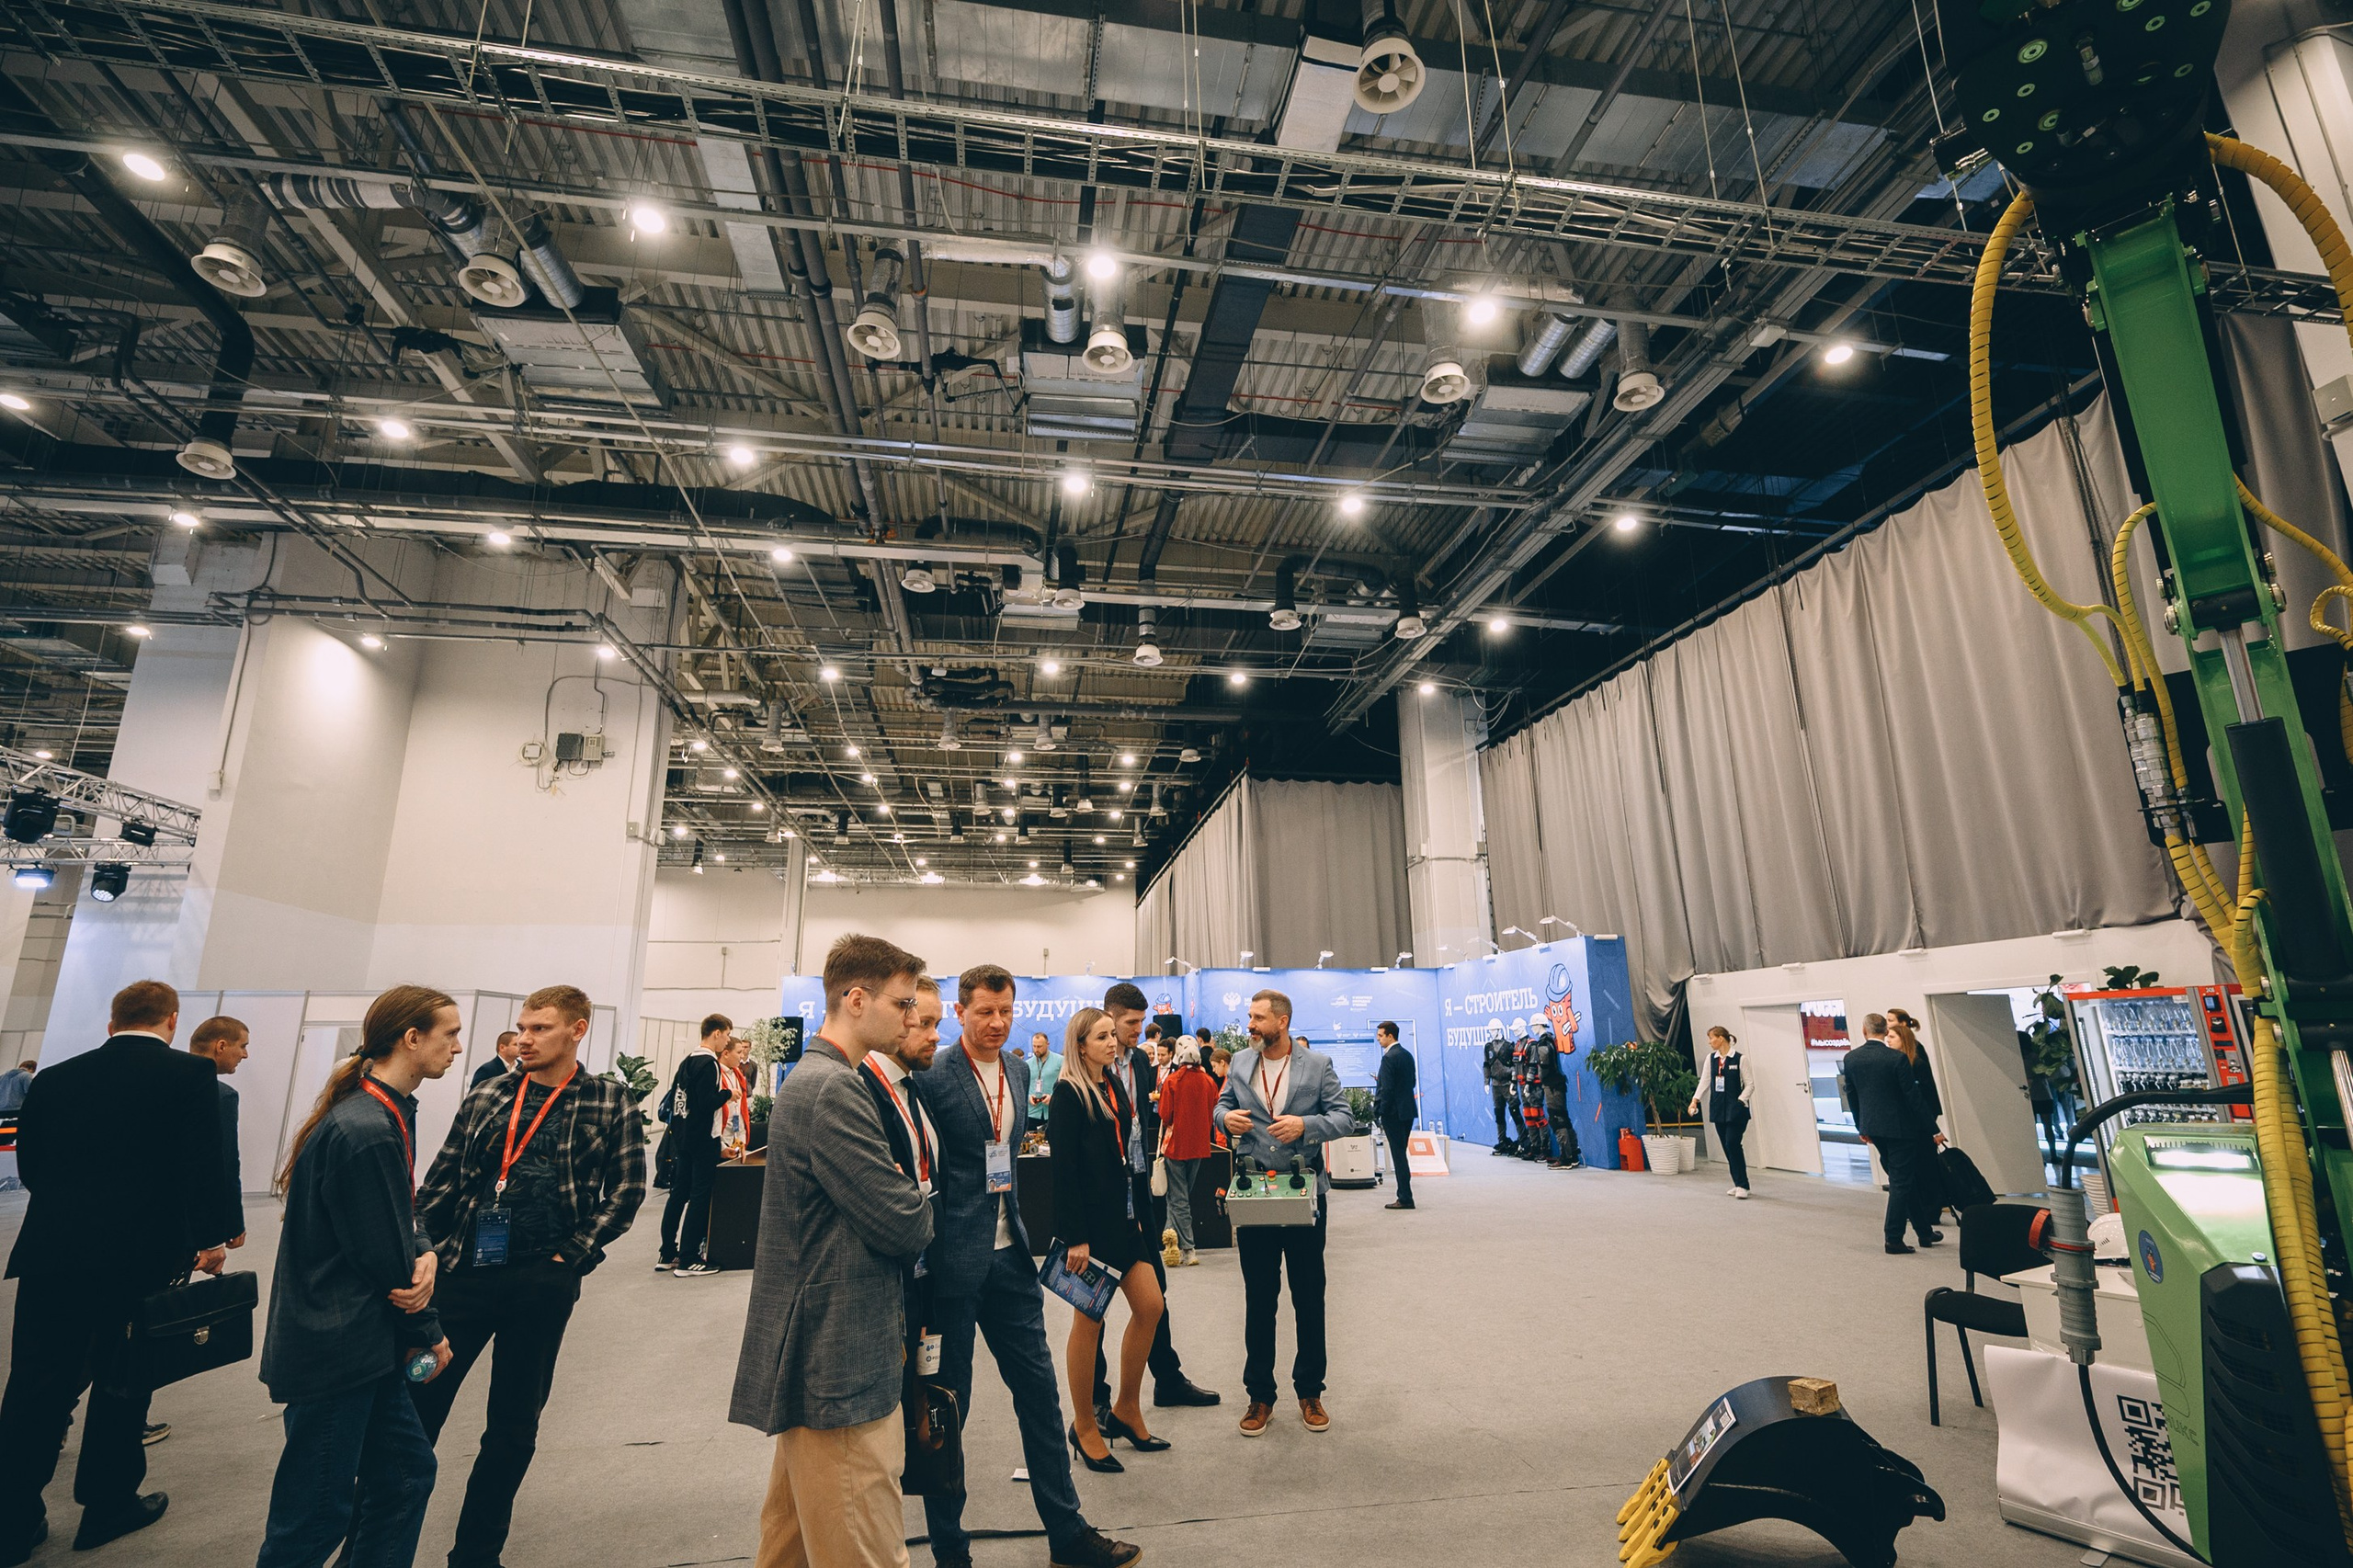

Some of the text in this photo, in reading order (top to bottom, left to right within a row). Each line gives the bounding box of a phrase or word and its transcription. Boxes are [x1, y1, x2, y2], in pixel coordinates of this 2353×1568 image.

[798, 1000, 816, 1019] Я
[1445, 997, 1452, 1017] Я
[1464, 987, 1539, 1015] СТРОИТЕЛЬ
